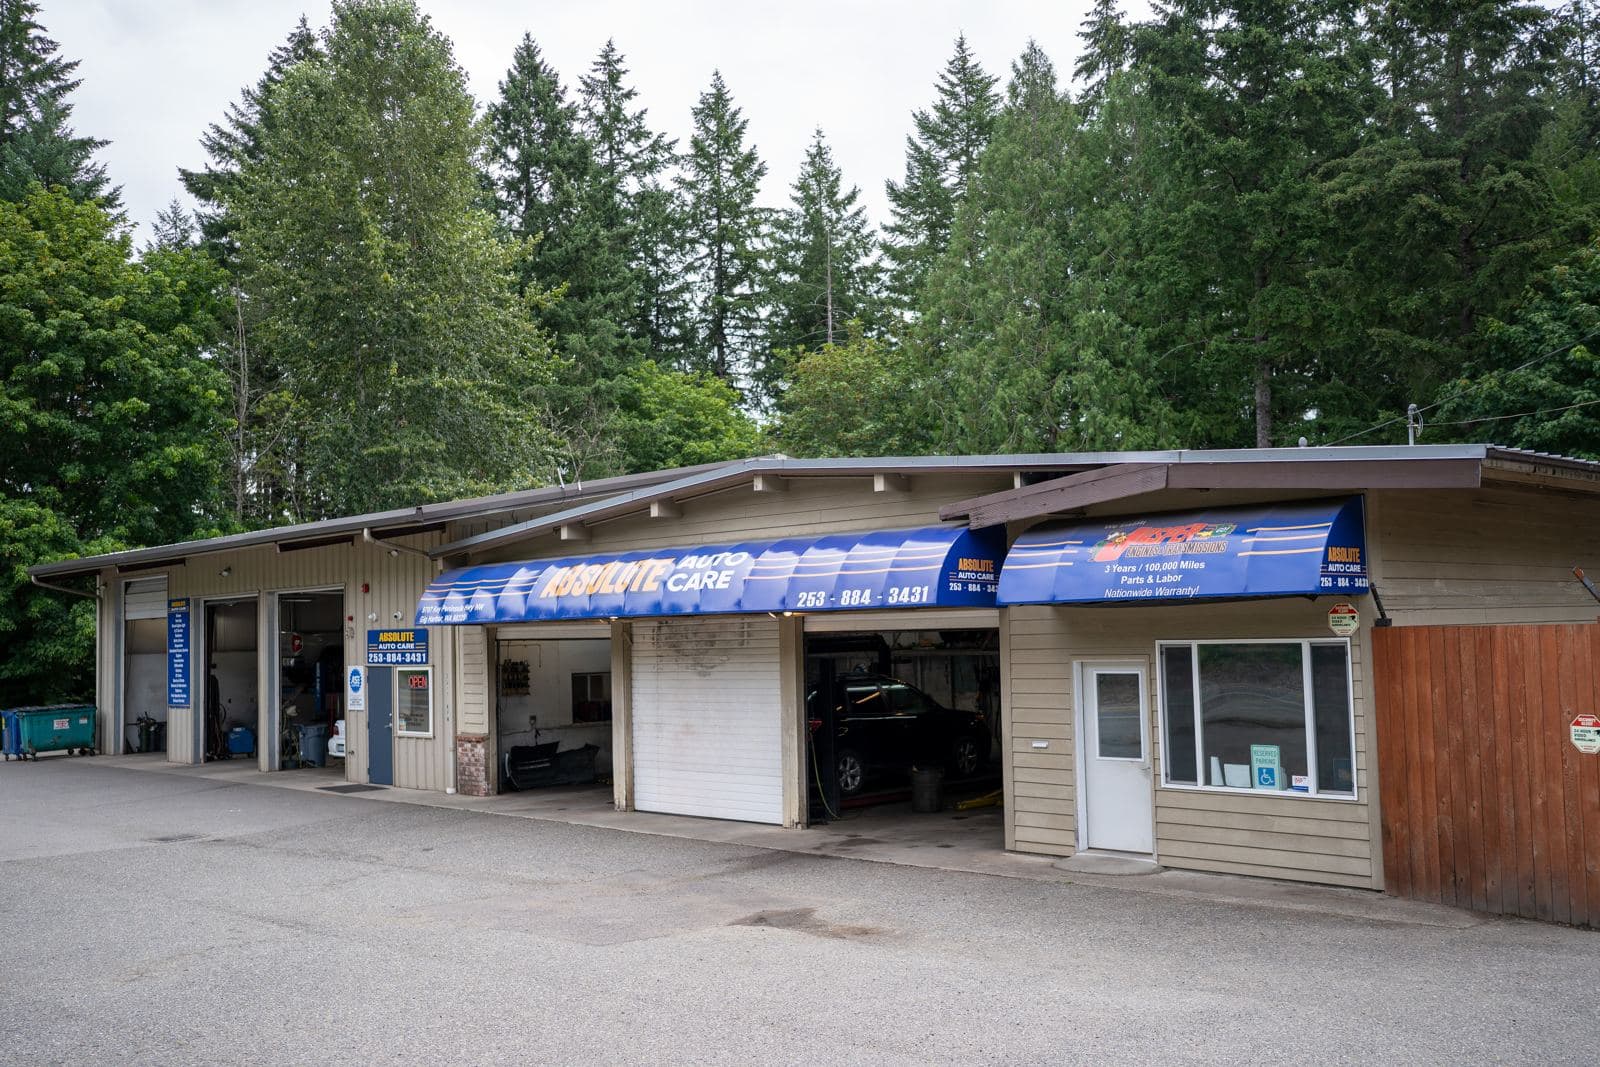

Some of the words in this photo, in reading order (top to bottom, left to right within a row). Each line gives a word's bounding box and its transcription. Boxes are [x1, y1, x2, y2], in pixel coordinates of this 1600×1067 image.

[1125, 545, 1159, 558] ENGINES
[1162, 541, 1228, 556] TRANSMISSIONS
[1328, 547, 1361, 562] ABSOLUTE
[676, 551, 750, 570] AUTO
[958, 558, 994, 572] ABSOLUTE
[1104, 565, 1111, 573] 3
[1112, 564, 1137, 573] Years
[1145, 561, 1178, 572] 100,000
[1179, 560, 1206, 569] Miles
[540, 558, 676, 599] ABSOLUTE
[666, 570, 735, 592] CARE
[1120, 575, 1145, 585] Parts
[1146, 574, 1154, 584] &
[1156, 574, 1183, 583] Labor
[1320, 578, 1332, 587] 253
[1354, 578, 1369, 587] 3431
[949, 583, 962, 591] 253
[968, 584, 981, 592] 884
[1103, 588, 1153, 598] Nationwide
[1155, 585, 1200, 598] Warranty!
[797, 591, 825, 607] 253
[840, 589, 871, 605] 884
[888, 586, 929, 603] 3431
[379, 632, 415, 642] ABSOLUTE
[368, 653, 426, 663] 253-884-3431
[409, 675, 427, 688] OPEN
